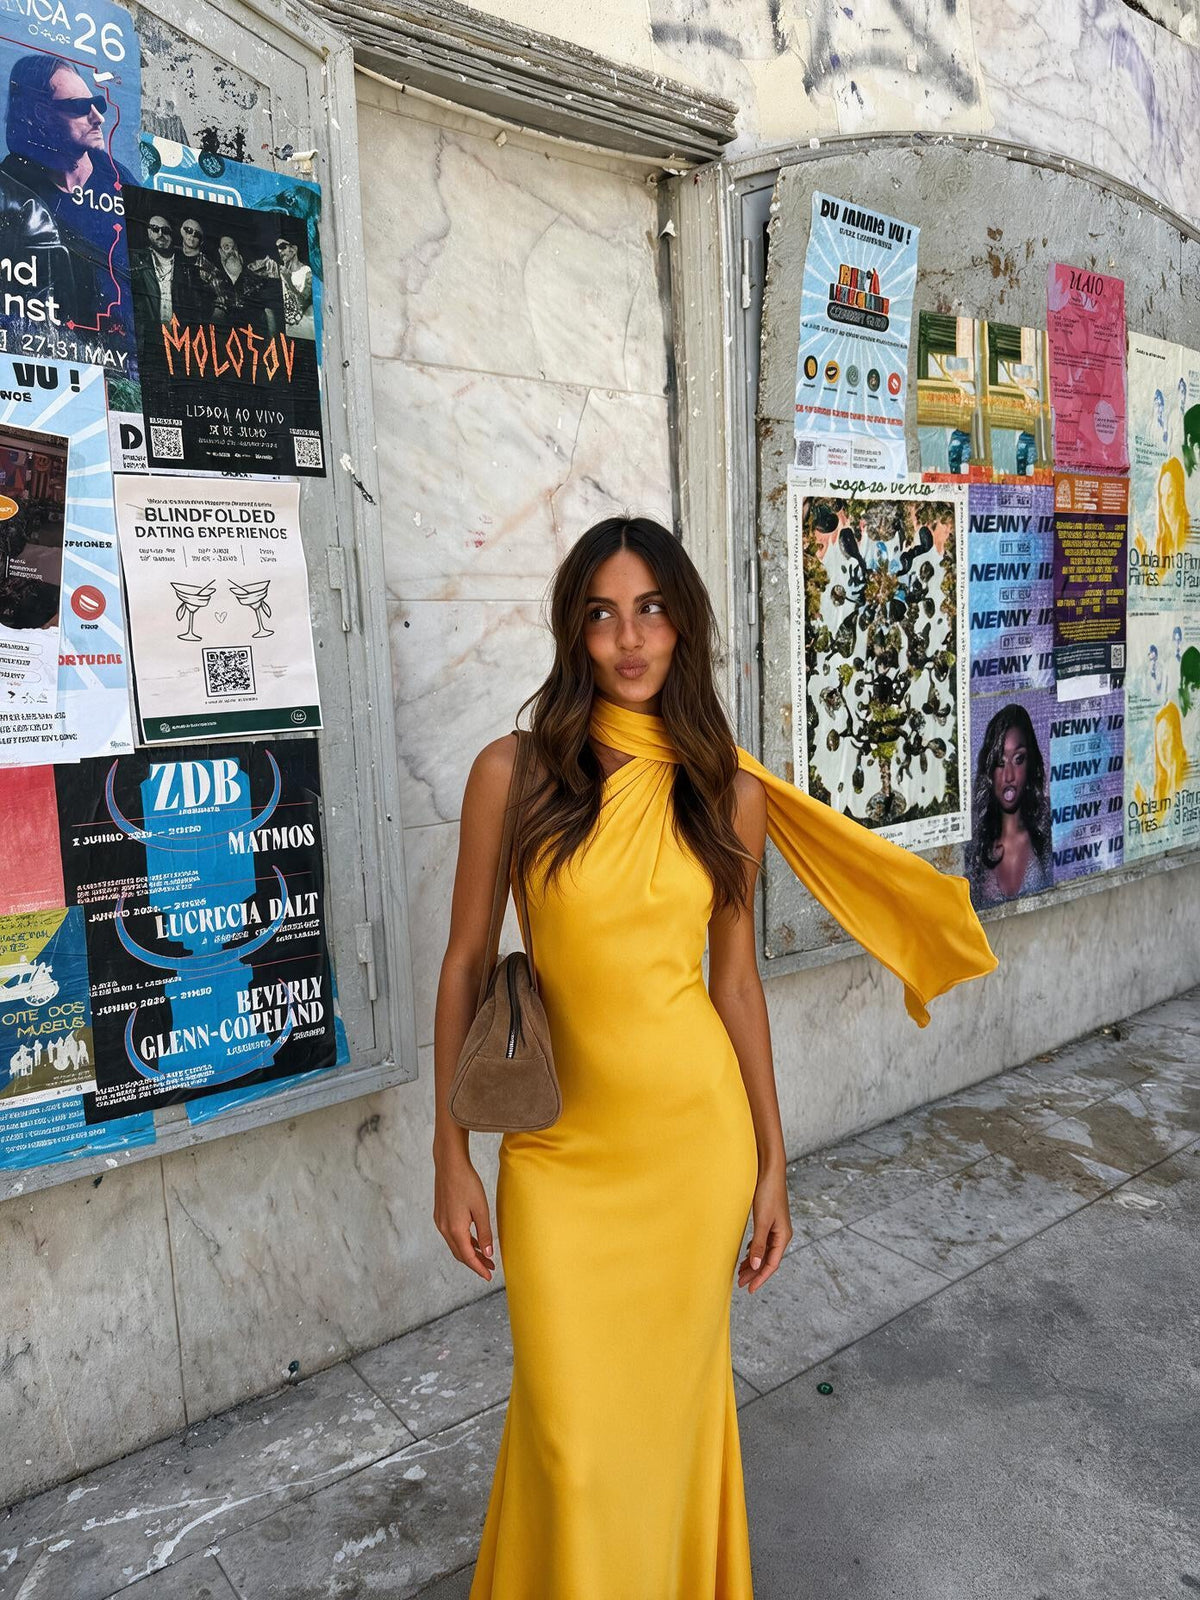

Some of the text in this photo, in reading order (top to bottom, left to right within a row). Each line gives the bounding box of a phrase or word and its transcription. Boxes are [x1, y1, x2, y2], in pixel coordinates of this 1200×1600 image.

[73, 12, 126, 62] 26
[72, 185, 125, 216] 31.05
[820, 199, 840, 220] DU
[85, 344, 128, 368] MAY
[12, 362, 59, 390] VU
[144, 507, 276, 523] BLINDFOLDED
[968, 514, 1032, 533] NENNY
[134, 526, 194, 539] DATING
[969, 563, 1032, 582] NENNY
[970, 609, 1032, 630] NENNY
[970, 654, 1032, 678] NENNY
[1050, 714, 1124, 739] NENNY ID
[1050, 755, 1124, 782] NENNY ID
[150, 759, 242, 811] ZDB
[1051, 800, 1102, 826] NENNY
[1107, 796, 1124, 813] ID
[228, 824, 316, 855] MATMOS
[1052, 835, 1124, 868] NENNY ID
[154, 900, 263, 940] LUCRECIA
[269, 892, 319, 922] DALT
[236, 976, 323, 1014] BEVERLY
[140, 1000, 325, 1060] GLENN-COPELAND
